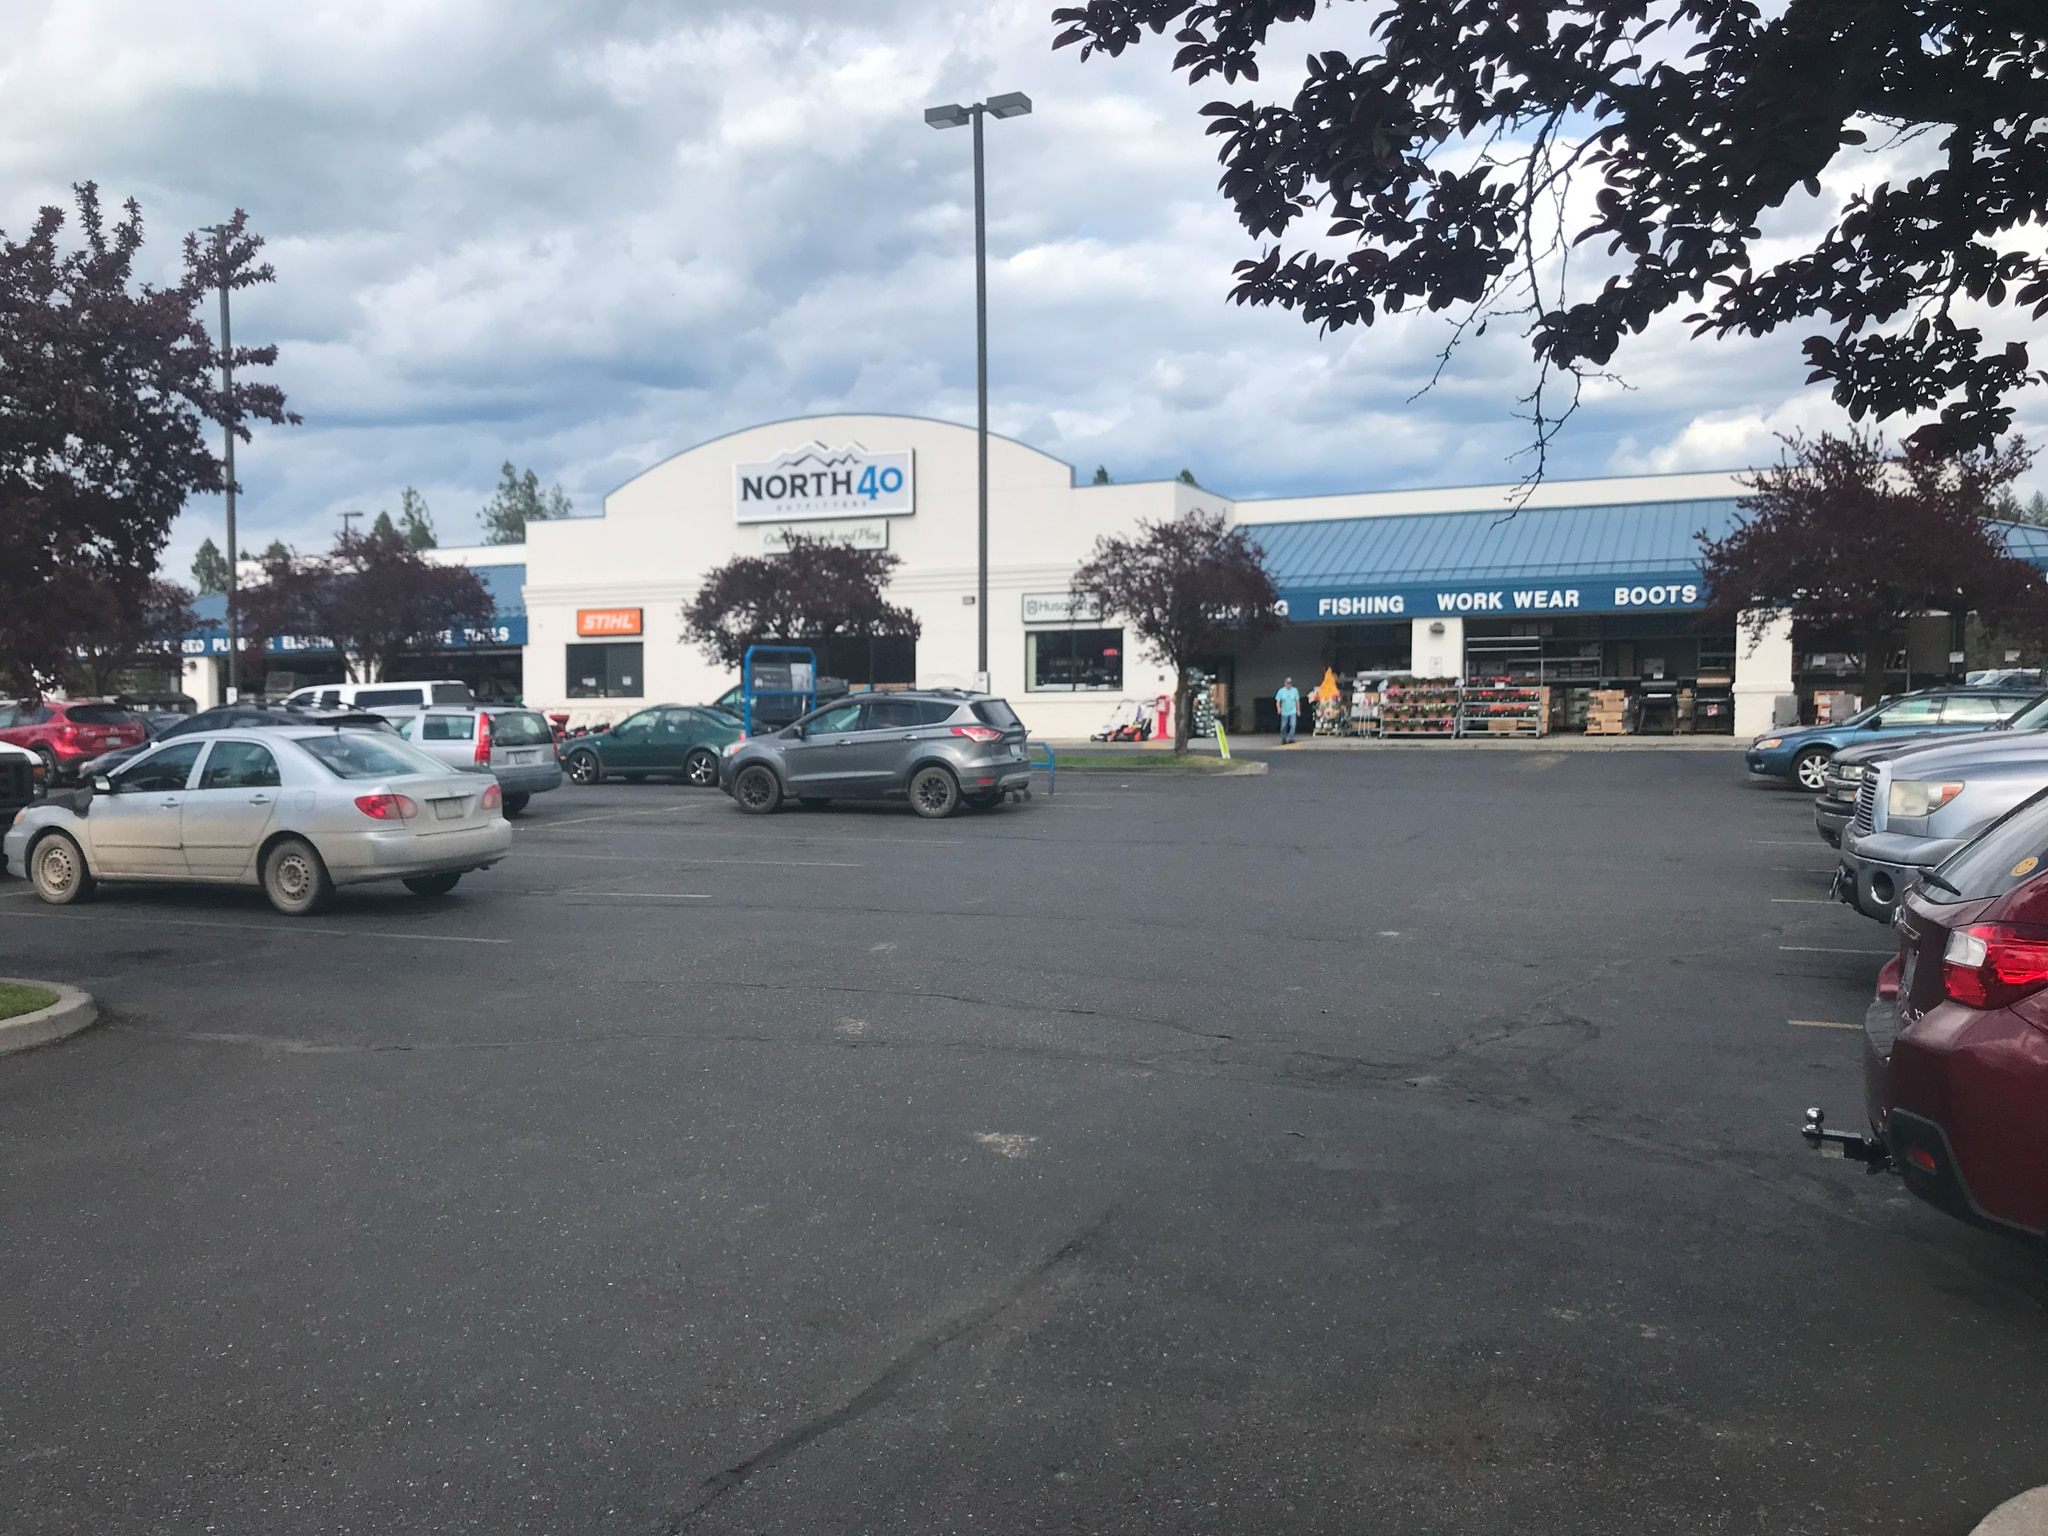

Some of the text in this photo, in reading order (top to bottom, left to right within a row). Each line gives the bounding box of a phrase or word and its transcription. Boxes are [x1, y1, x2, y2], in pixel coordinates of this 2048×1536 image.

[741, 465, 904, 501] NORTH 40
[858, 527, 881, 543] Play
[1318, 595, 1404, 616] FISHING
[1437, 592, 1503, 611] WORK
[1513, 589, 1580, 609] WEAR
[1615, 585, 1698, 606] BOOTS
[583, 613, 634, 630] STIHL
